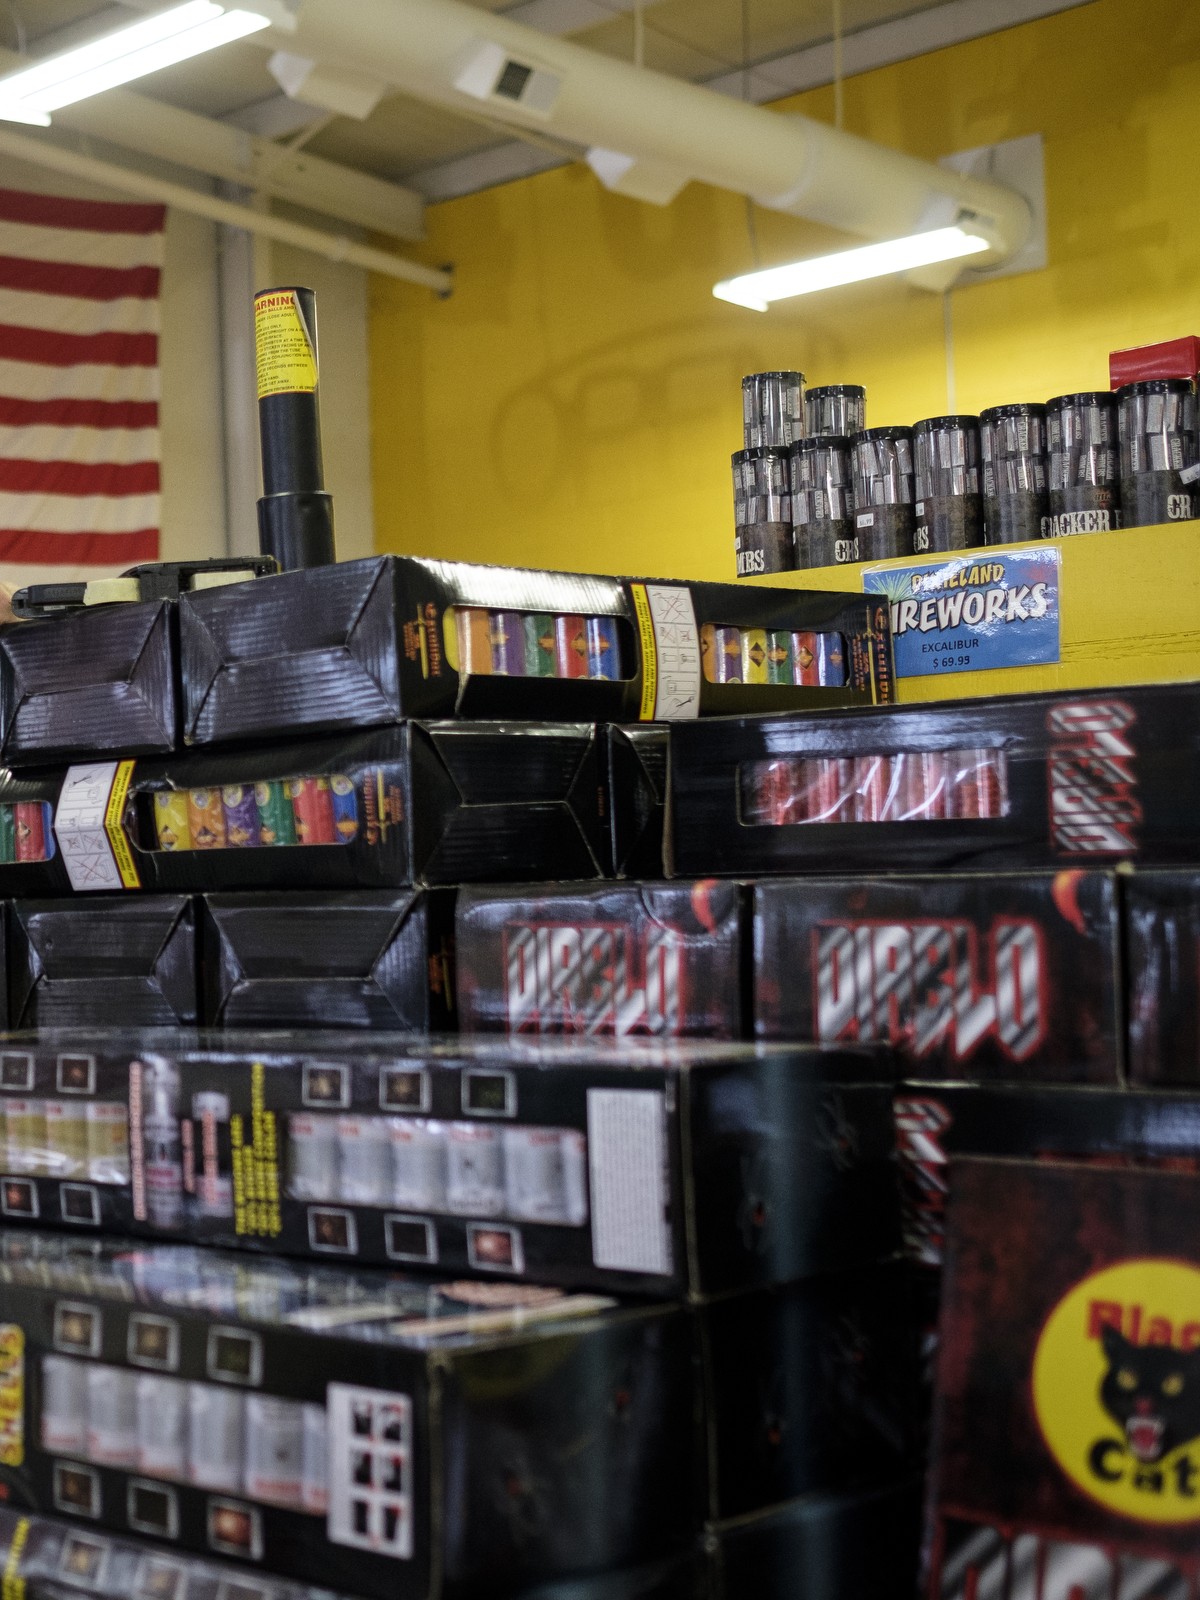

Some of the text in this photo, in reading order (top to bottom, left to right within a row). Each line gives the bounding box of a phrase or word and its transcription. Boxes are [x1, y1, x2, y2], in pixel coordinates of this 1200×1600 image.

[911, 562, 1005, 593] DIELAND
[891, 582, 1048, 635] IREWORKS
[922, 638, 979, 653] EXCALIBUR
[933, 657, 939, 669] $
[1047, 701, 1142, 856] DIABLO
[815, 917, 1045, 1062] DIABLO
[1087, 1437, 1200, 1500] Cat
